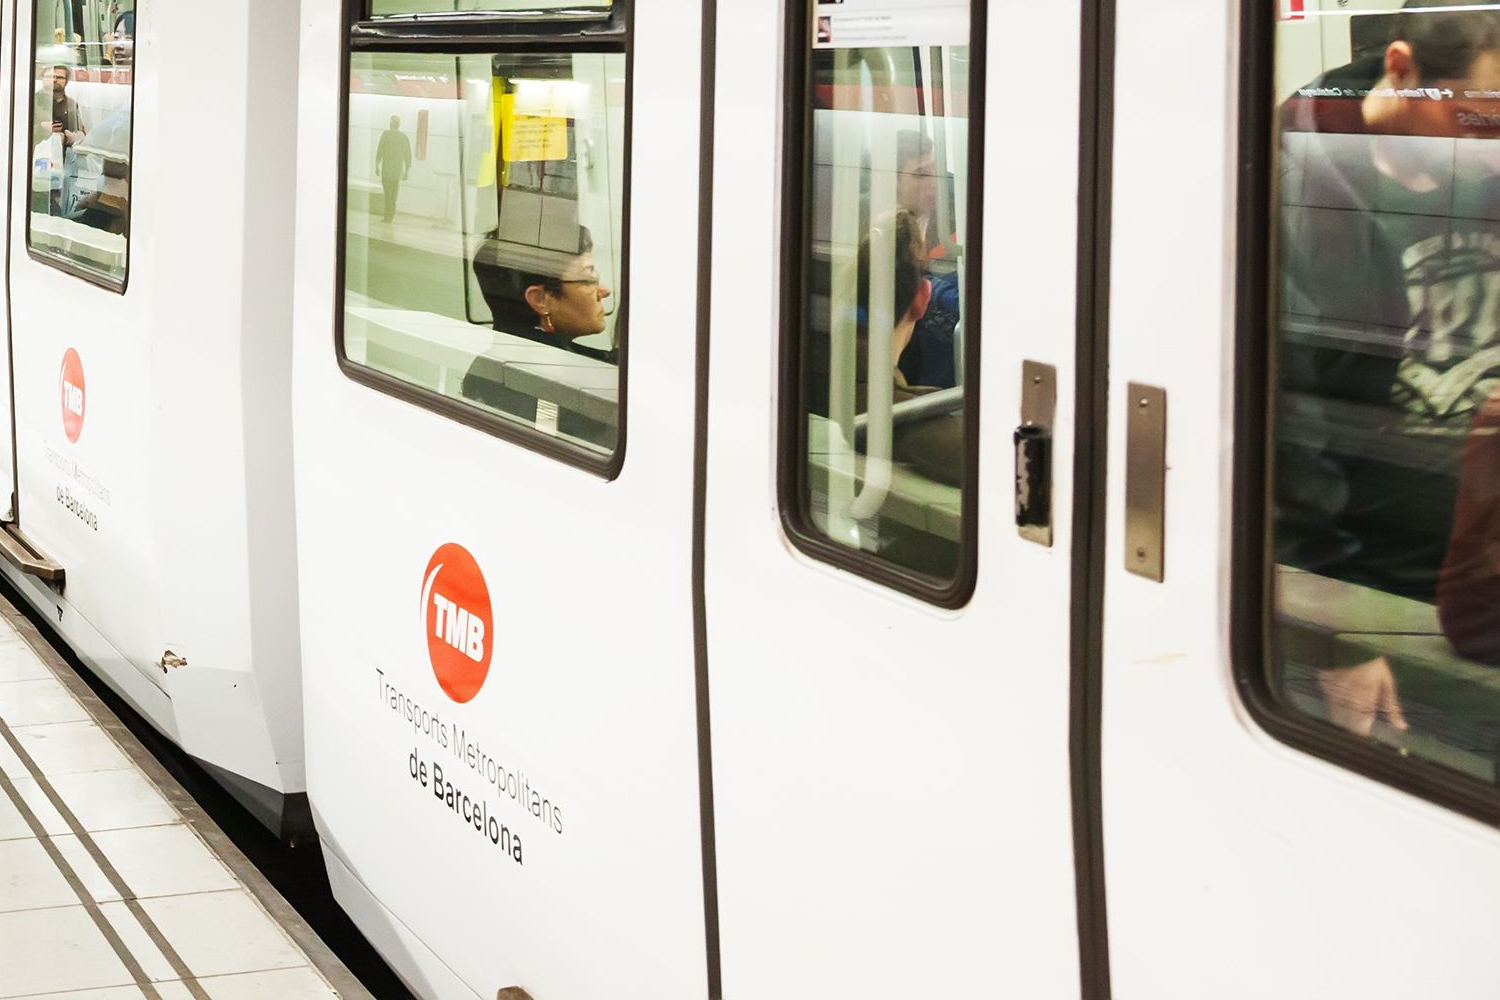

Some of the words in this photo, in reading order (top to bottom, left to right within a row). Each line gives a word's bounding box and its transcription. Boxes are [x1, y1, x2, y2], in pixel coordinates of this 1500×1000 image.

[63, 379, 83, 417] TMB
[434, 592, 485, 663] TMB
[375, 666, 449, 749] Transports
[452, 722, 564, 835] Metropolitans
[408, 747, 428, 788] de
[432, 761, 524, 866] Barcelona
